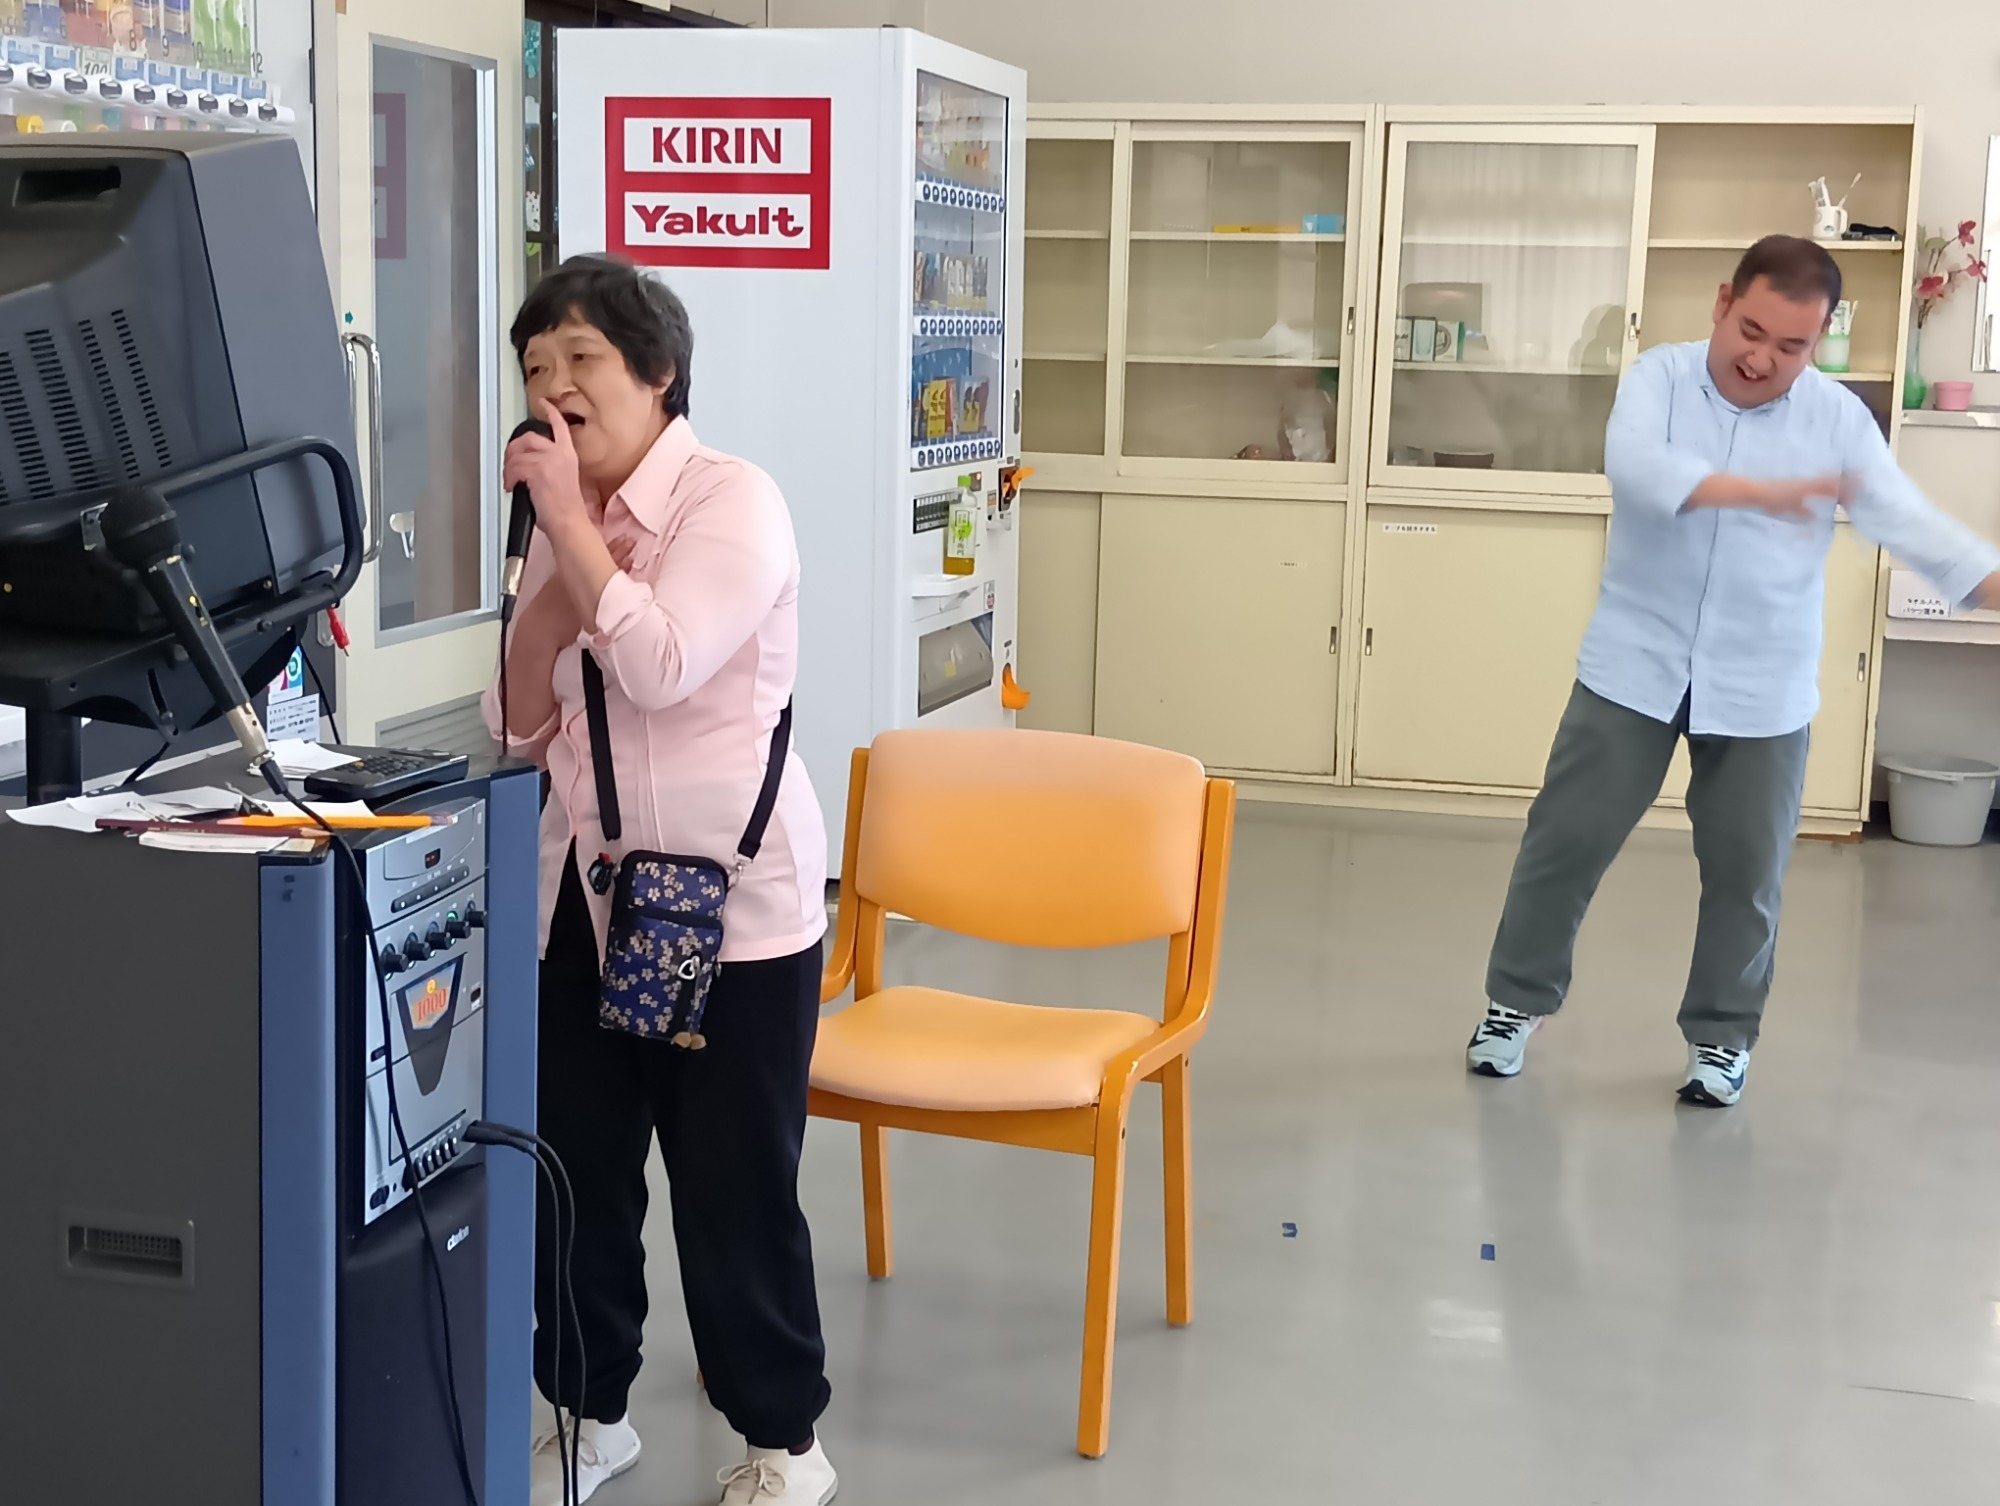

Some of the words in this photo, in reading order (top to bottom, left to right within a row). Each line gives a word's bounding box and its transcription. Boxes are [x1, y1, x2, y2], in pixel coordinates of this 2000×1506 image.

[129, 29, 138, 52] 8
[162, 35, 170, 58] 9
[191, 41, 204, 63] 10
[251, 52, 264, 74] 12
[653, 126, 782, 164] KIRIN
[631, 204, 804, 237] Yakult
[417, 988, 448, 1022] 1000
